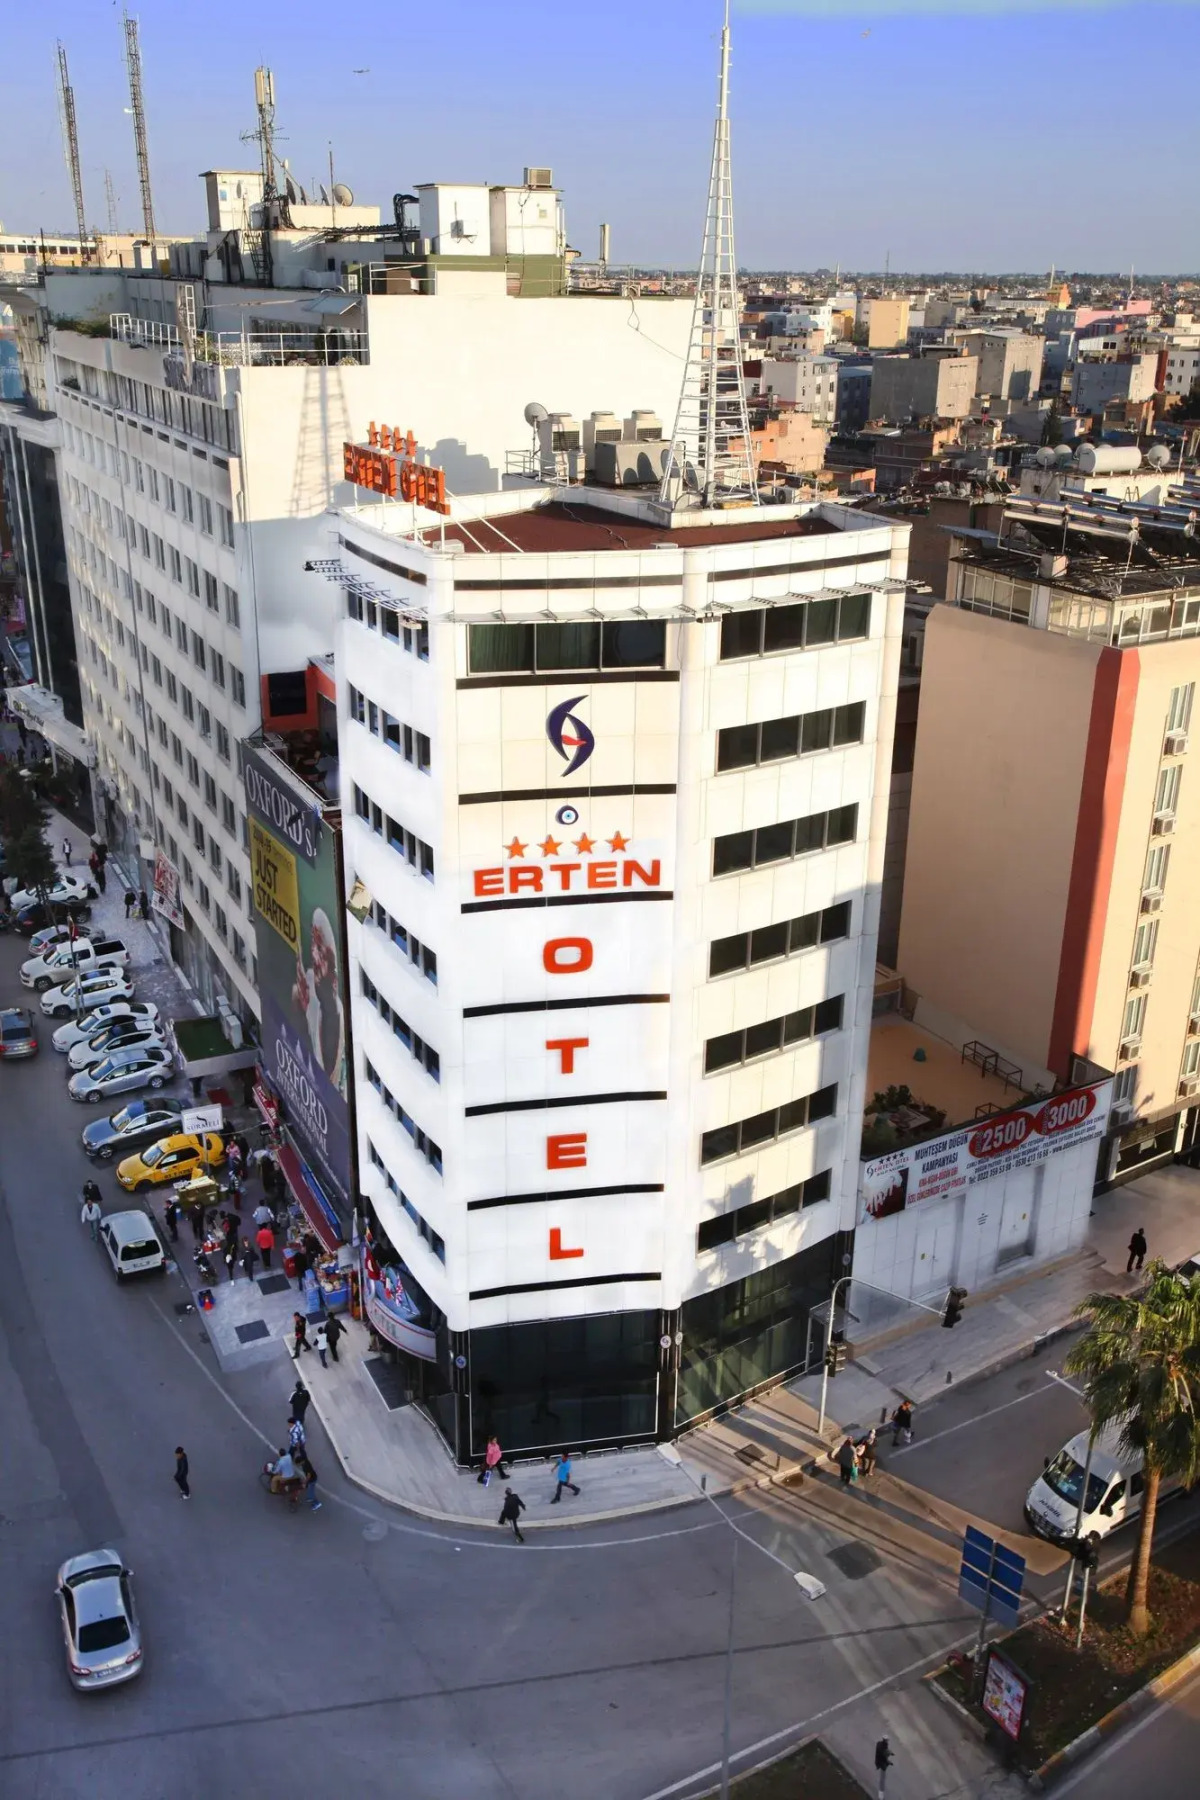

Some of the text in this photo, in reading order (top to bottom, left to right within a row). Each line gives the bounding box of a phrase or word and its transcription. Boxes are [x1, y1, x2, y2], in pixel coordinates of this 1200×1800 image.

[256, 855, 278, 894] JUST
[473, 859, 661, 897] ERTEN
[256, 883, 297, 943] STARTED
[275, 1038, 328, 1135] OXFORD
[1047, 1095, 1087, 1129] 3000
[914, 1140, 948, 1161] MUHTEŞEM
[982, 1117, 1026, 1152] 2500
[921, 1152, 959, 1174] KAMPANYASI
